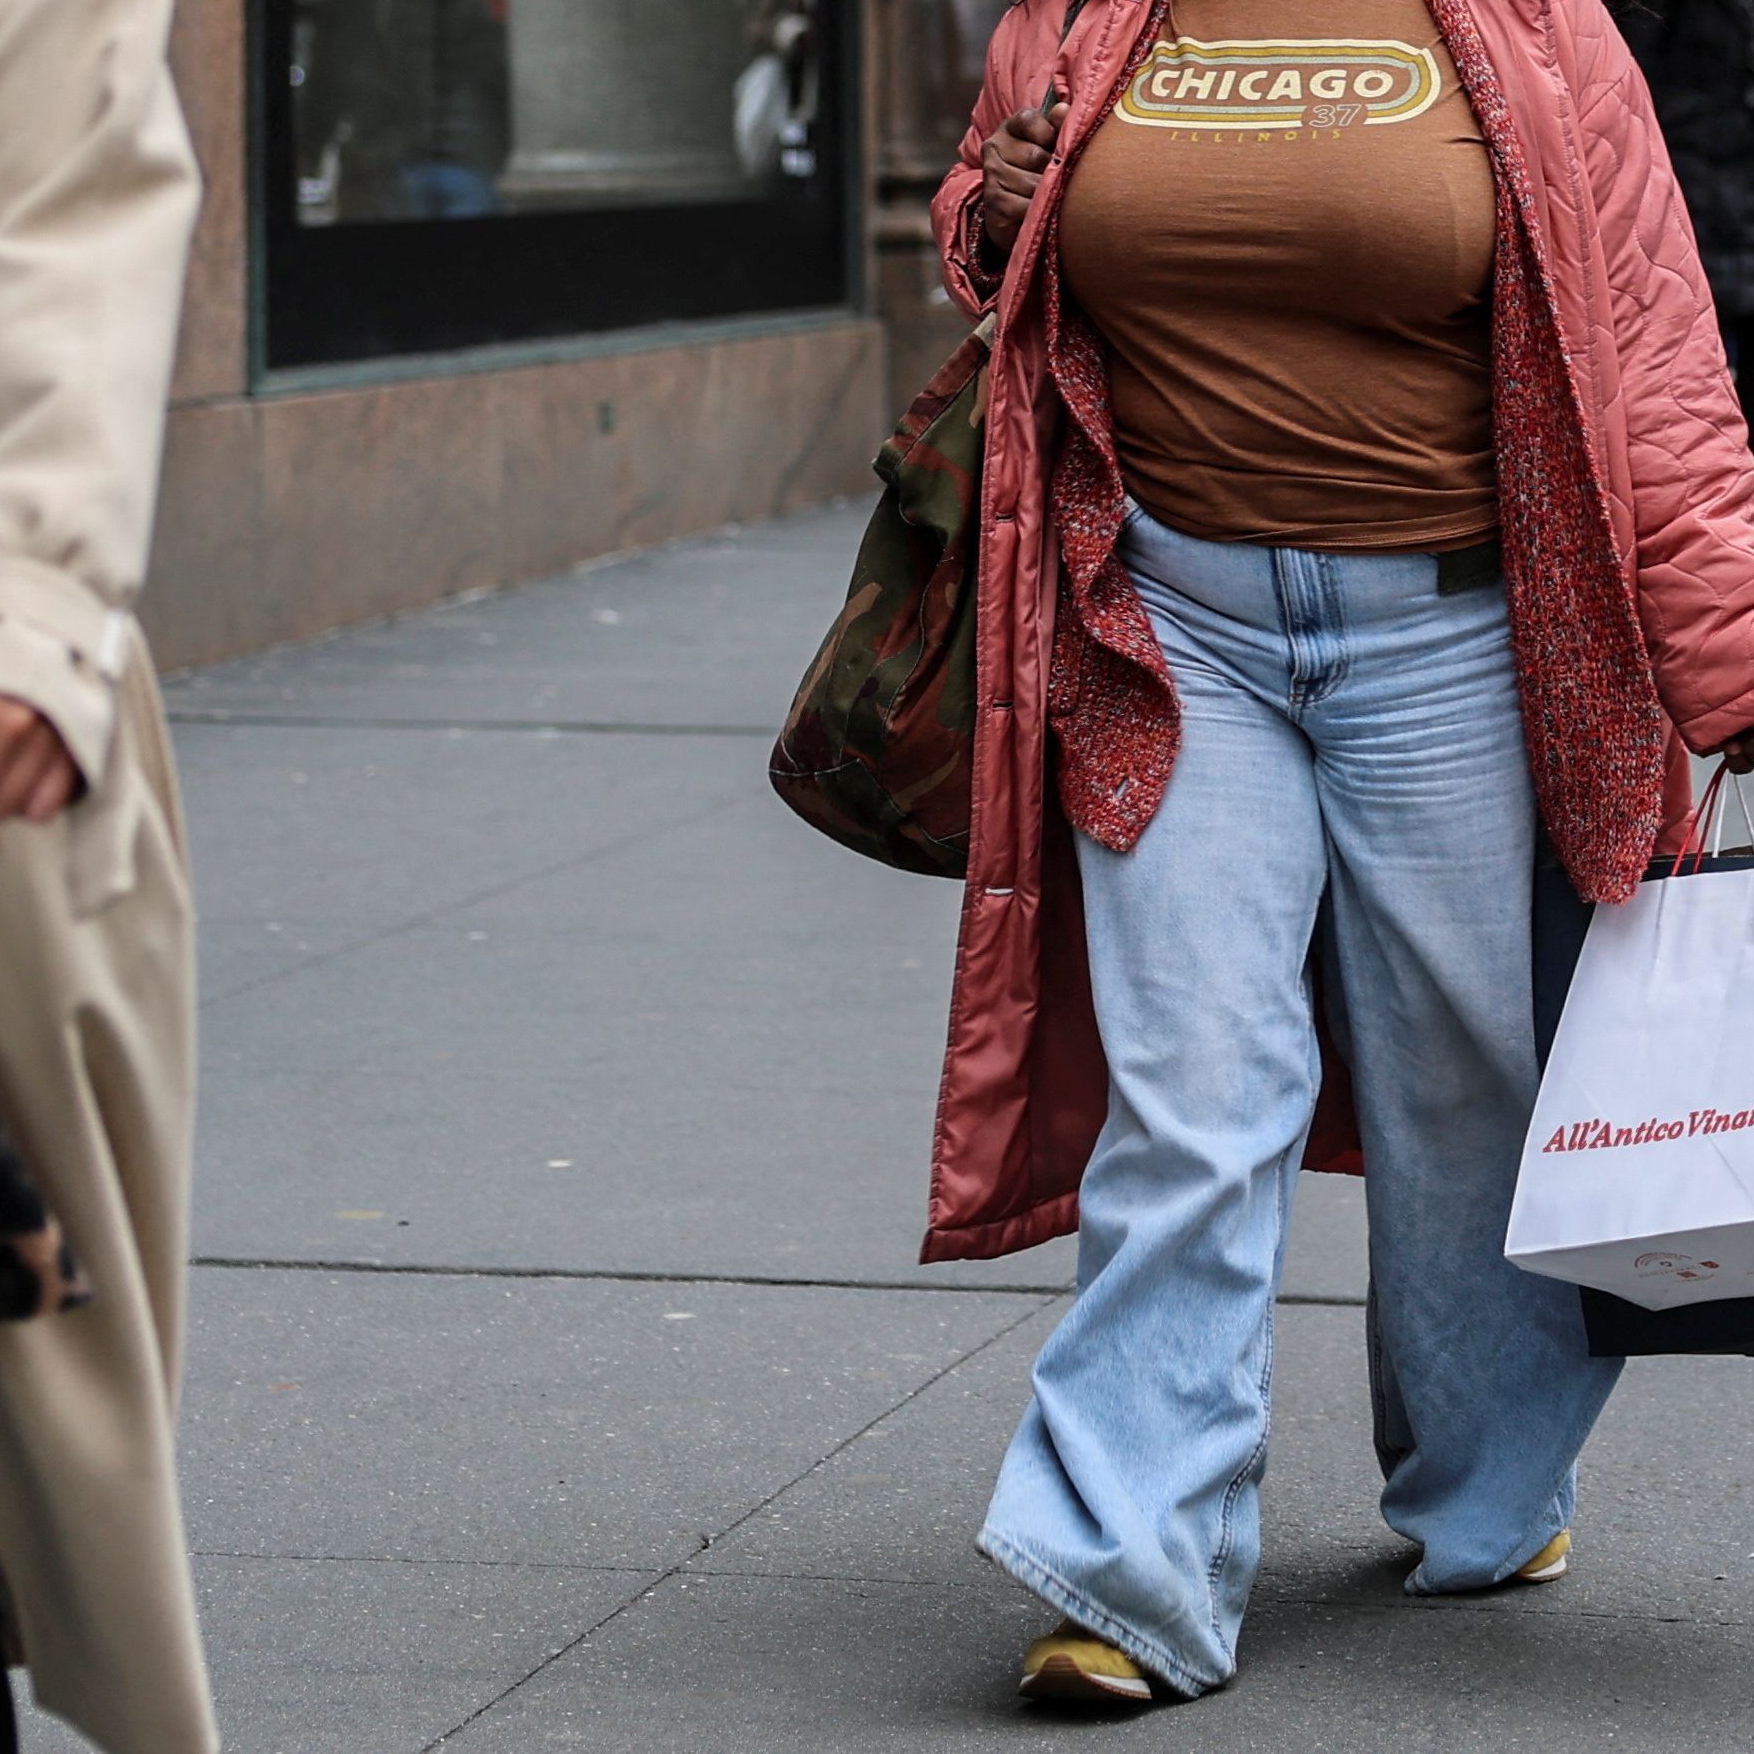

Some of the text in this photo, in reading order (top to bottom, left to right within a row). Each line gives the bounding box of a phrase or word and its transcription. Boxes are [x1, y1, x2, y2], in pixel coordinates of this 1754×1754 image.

[1150, 67, 1395, 101] CHICAGO
[1308, 103, 1364, 128] 37
[1169, 129, 1342, 143] ILLINOIS
[1542, 1117, 1685, 1154] All'Antico
